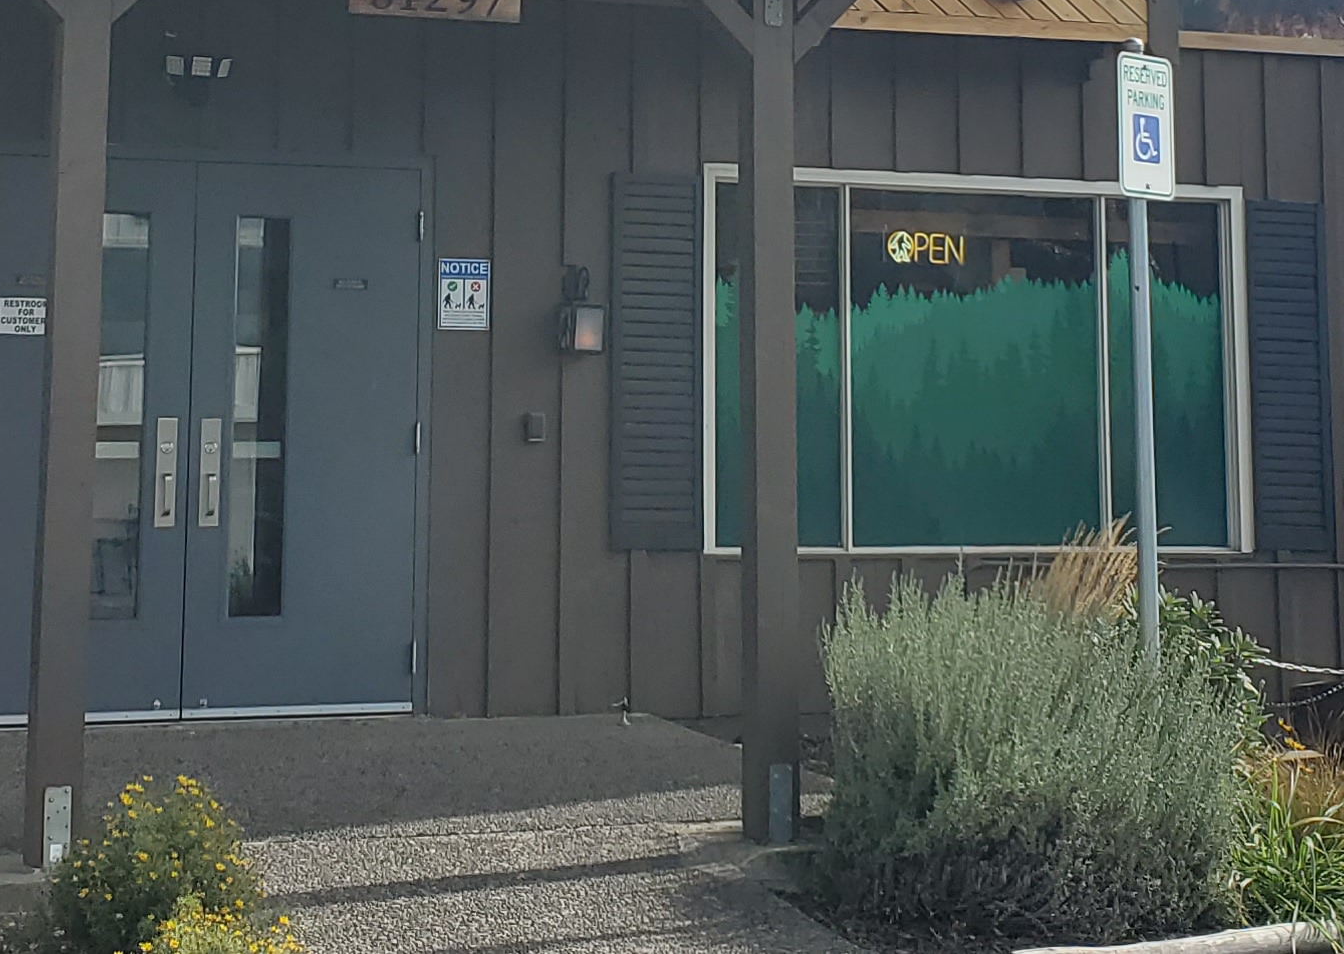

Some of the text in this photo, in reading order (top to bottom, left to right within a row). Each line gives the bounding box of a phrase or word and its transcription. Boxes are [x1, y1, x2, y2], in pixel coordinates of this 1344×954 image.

[1123, 65, 1167, 87] RESERVED
[1127, 89, 1165, 110] PARKING
[887, 230, 965, 265] OPEN
[441, 262, 488, 275] NOTICE
[14, 325, 37, 333] ONLY
